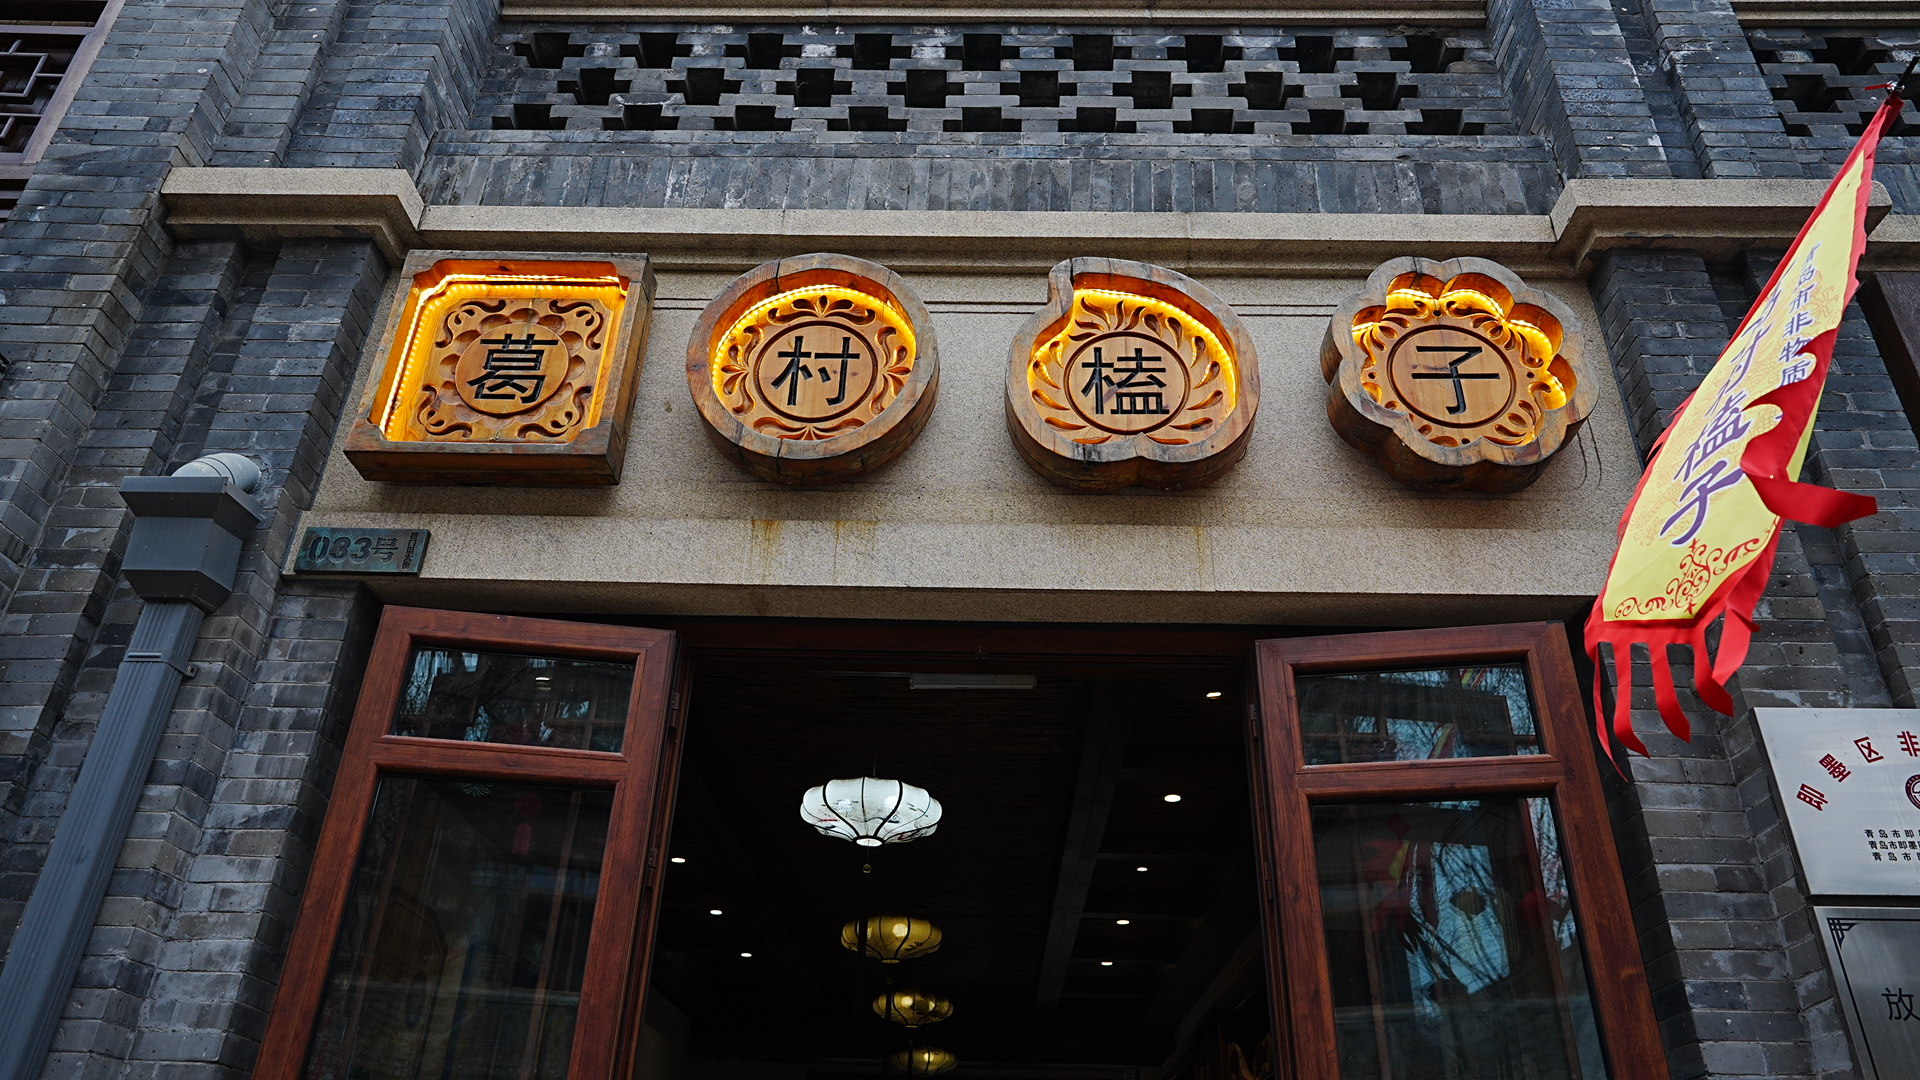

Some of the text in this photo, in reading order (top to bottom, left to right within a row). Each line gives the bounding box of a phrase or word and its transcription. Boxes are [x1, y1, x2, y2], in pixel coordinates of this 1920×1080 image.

[308, 536, 399, 563] 033号
[1864, 829, 1920, 838] 青岛市即
[1868, 841, 1920, 850] 青岛市即墨
[1881, 987, 1920, 1021] 放
